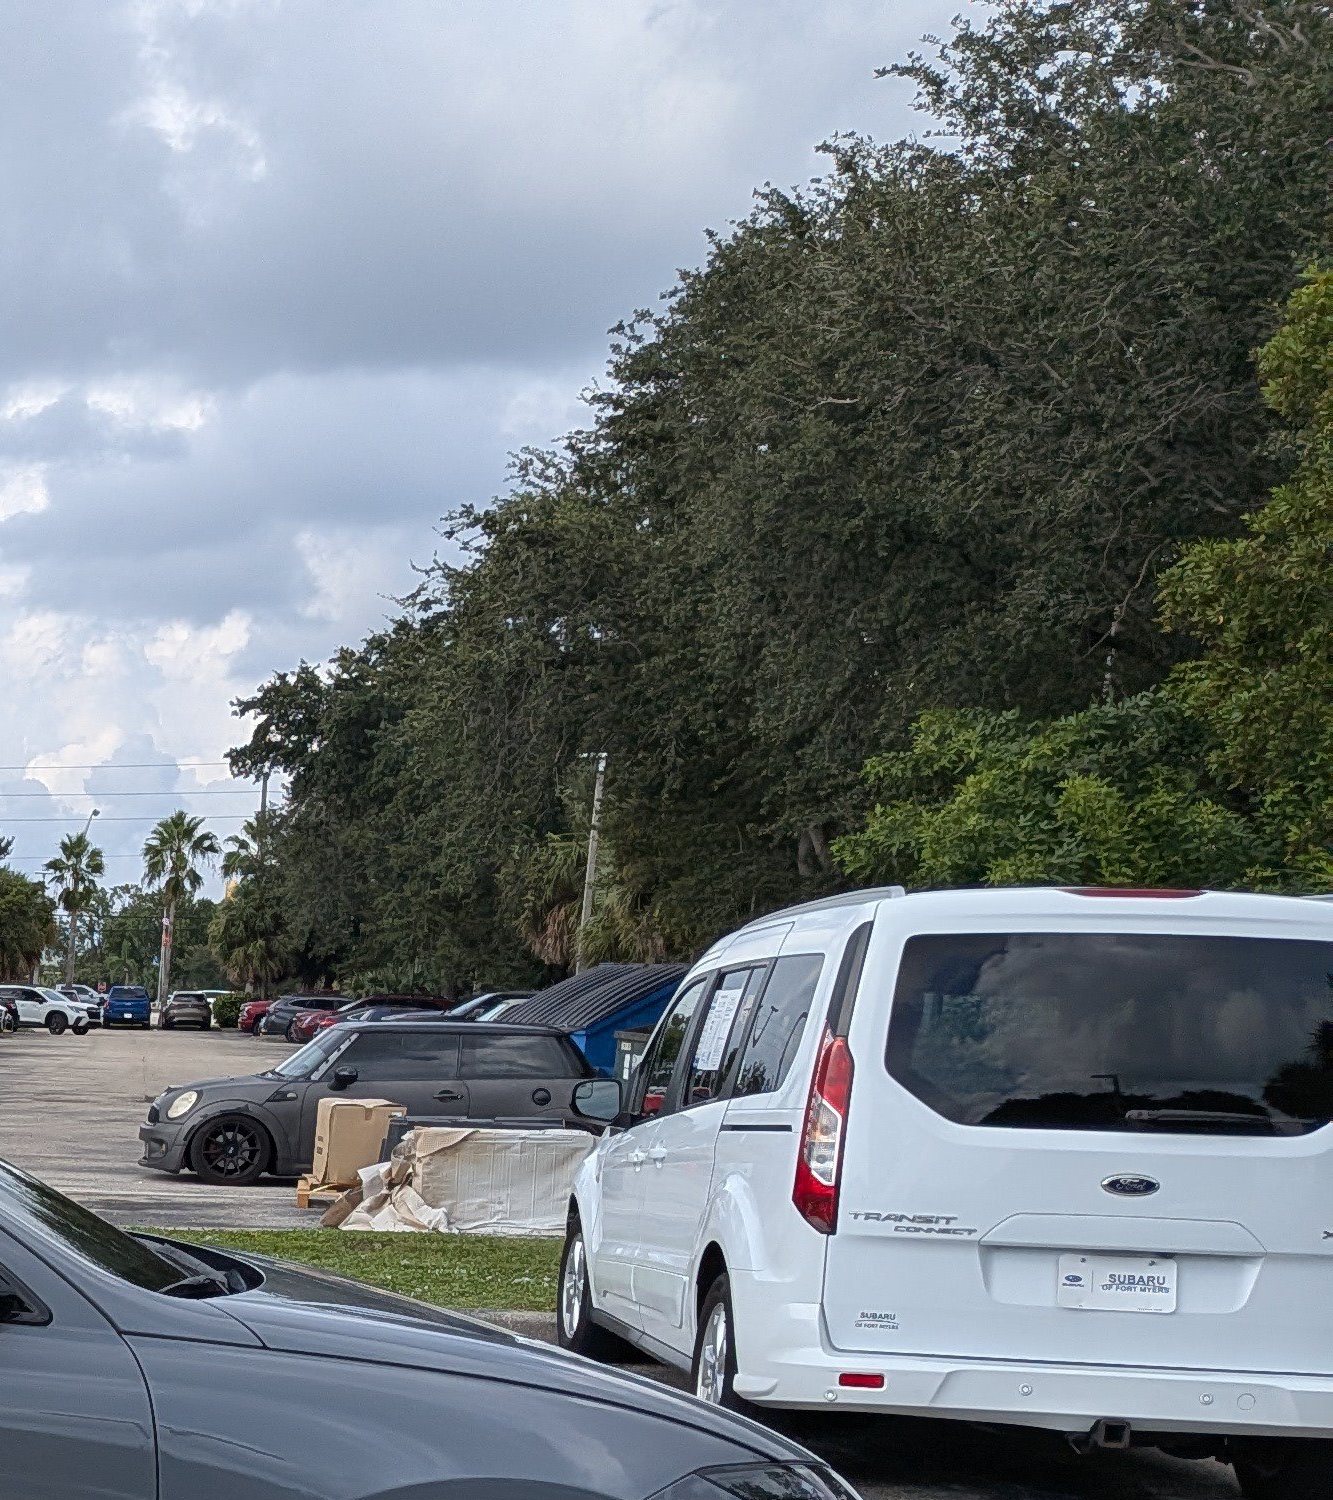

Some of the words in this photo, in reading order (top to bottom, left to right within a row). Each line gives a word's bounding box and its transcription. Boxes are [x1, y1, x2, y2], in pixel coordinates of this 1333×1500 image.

[849, 1210, 958, 1224] TRANSIT
[893, 1225, 978, 1235] CONNECT
[1108, 1273, 1166, 1286] SUBARU
[1115, 1284, 1137, 1292] FORT
[1139, 1285, 1170, 1294] MYERS
[860, 1311, 896, 1320] SUBARU
